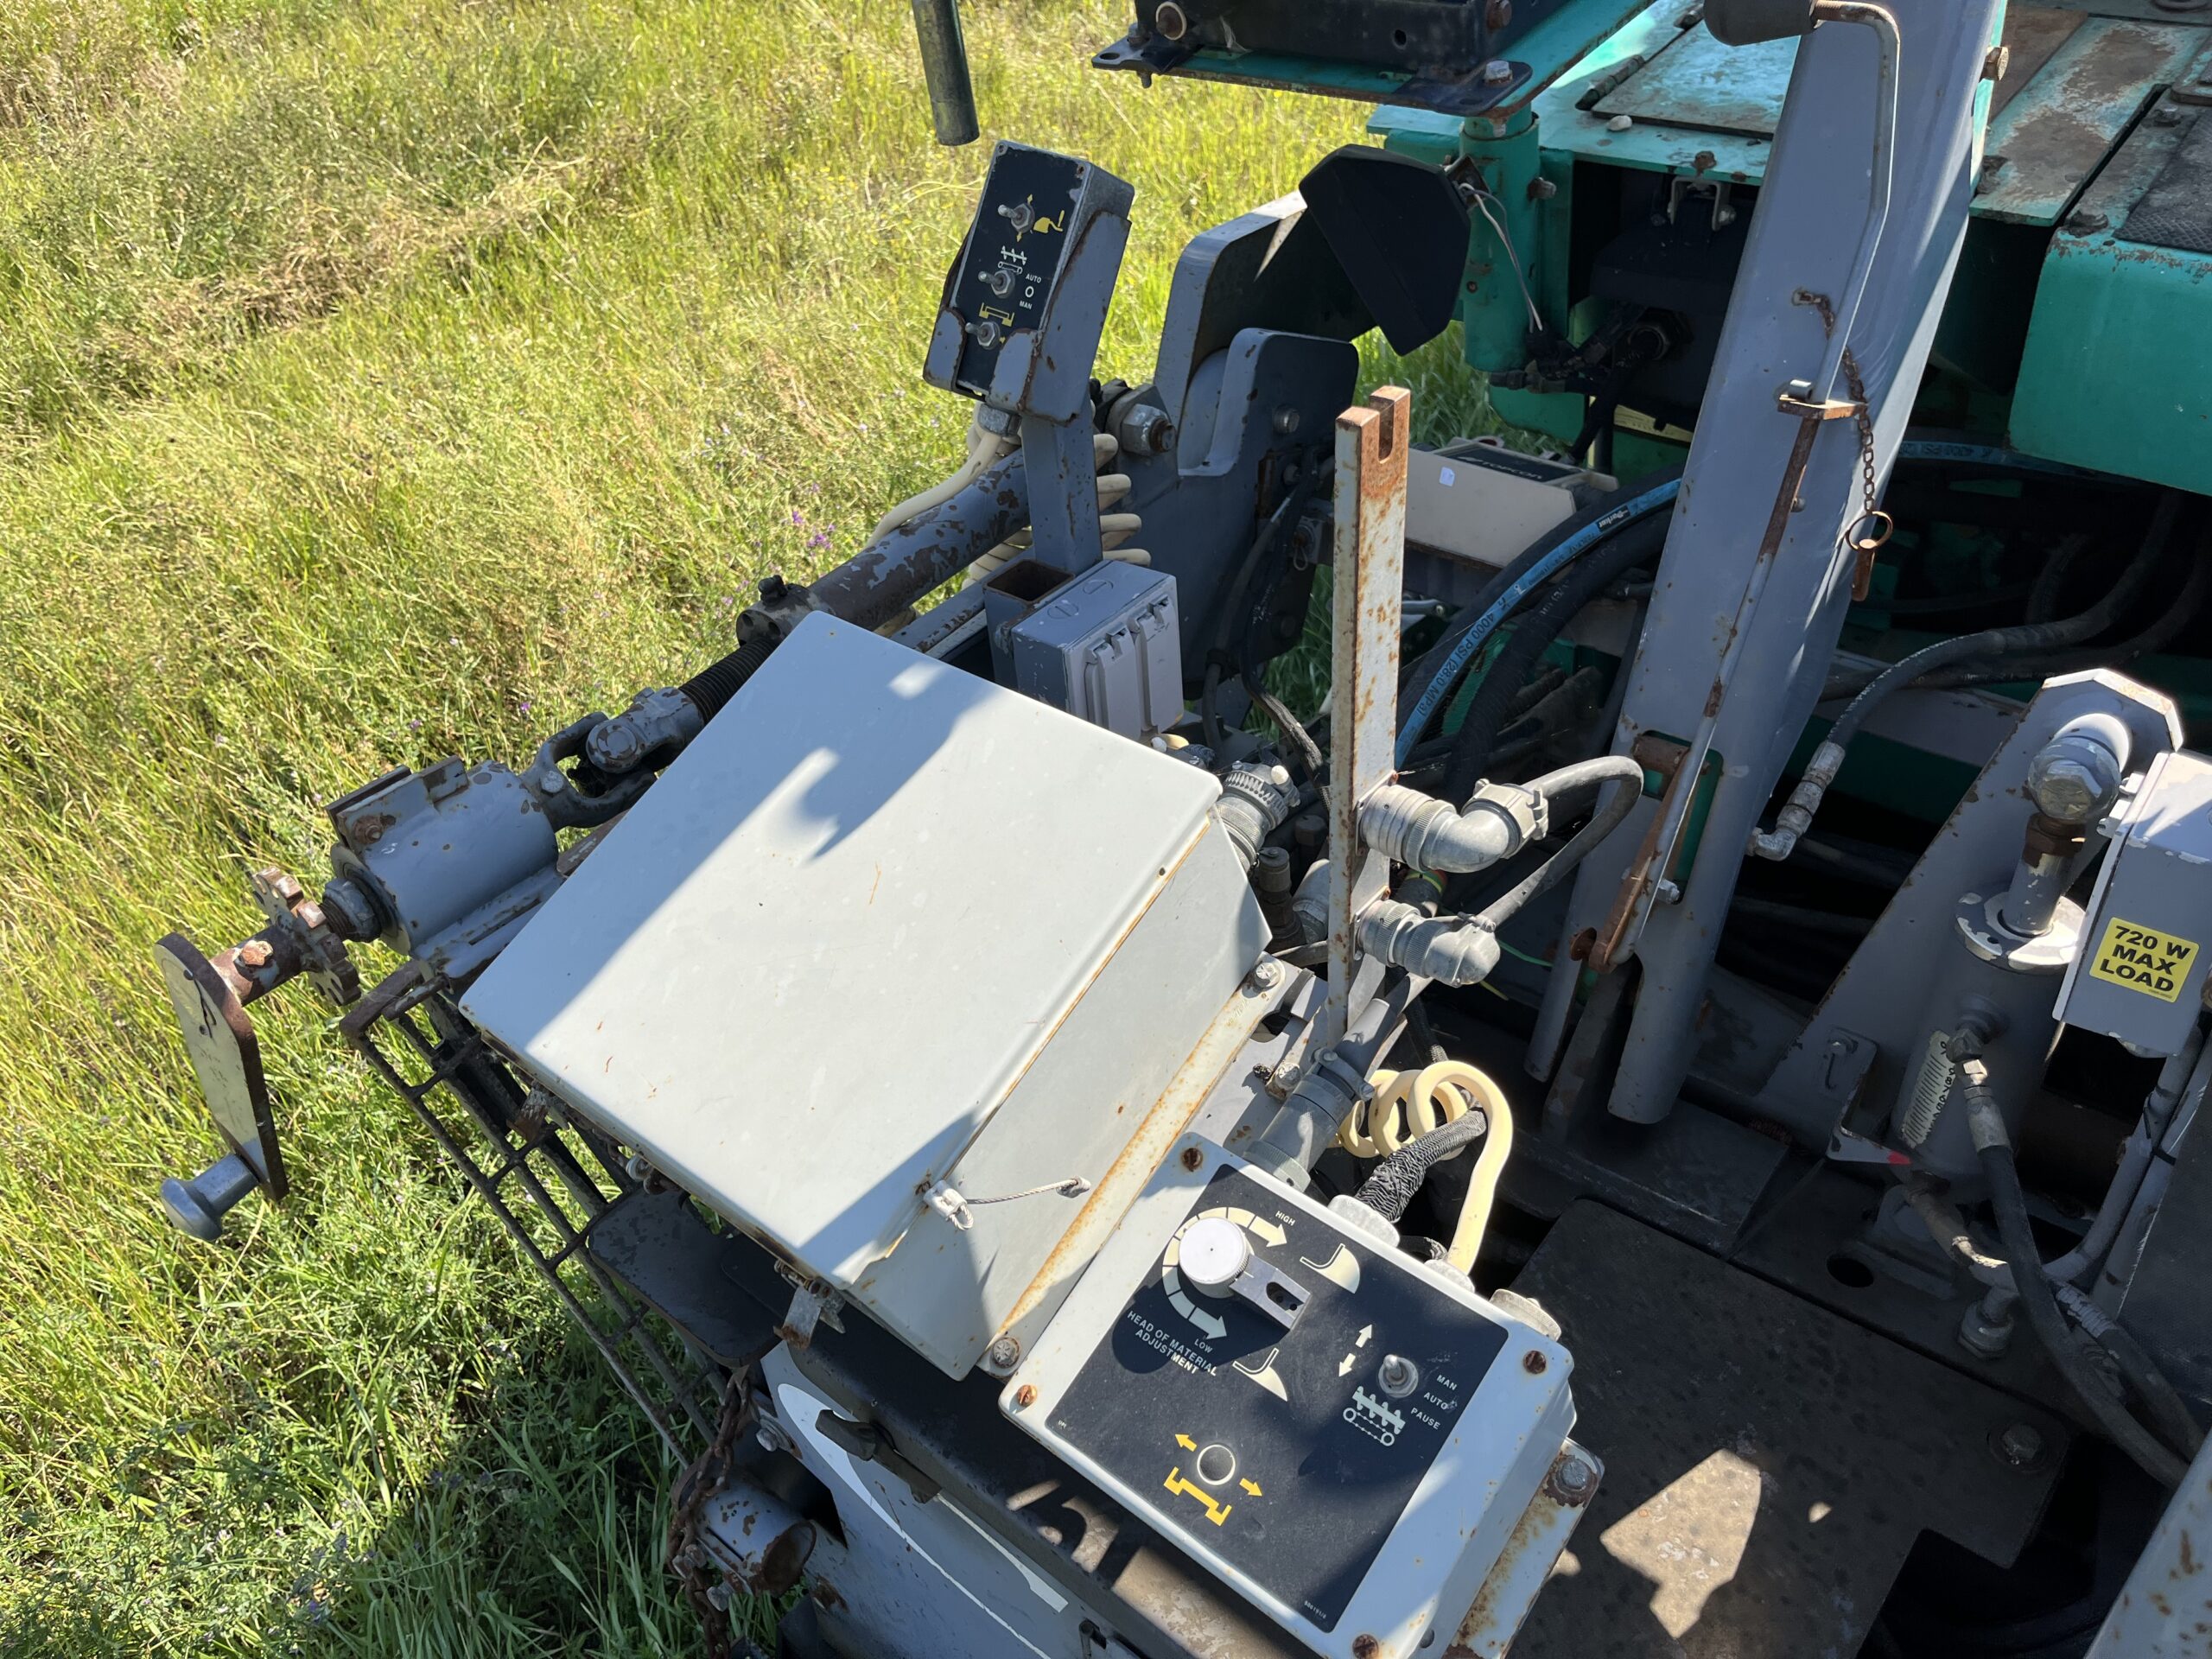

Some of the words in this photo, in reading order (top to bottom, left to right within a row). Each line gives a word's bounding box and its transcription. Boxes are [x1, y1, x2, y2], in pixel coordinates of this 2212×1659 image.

[1026, 273, 1042, 283] AUTO
[1019, 300, 1033, 310] MAN
[1483, 461, 1542, 480] TOPCON
[1599, 510, 1626, 528] Parker
[1471, 613, 1495, 639] 4000
[1458, 638, 1474, 660] PSI
[1417, 686, 1439, 716] MPa)
[2115, 925, 2158, 950] 720
[2166, 942, 2191, 960] W
[2112, 944, 2177, 976] MAX
[2100, 958, 2174, 992] LOAD
[1945, 1077, 1953, 1085] 8
[1939, 1094, 1947, 1103] 6
[1274, 1211, 1296, 1226] HIGH
[1127, 1311, 1154, 1332] HEAD
[1154, 1329, 1170, 1342] OF
[1169, 1338, 1217, 1376] MATERIAL
[1135, 1329, 1199, 1374] ADJUSTMENT
[1194, 1338, 1213, 1353] LOW
[1436, 1374, 1458, 1390] MAN
[1423, 1391, 1449, 1410] AUTO
[1410, 1407, 1441, 1430] PAUSE
